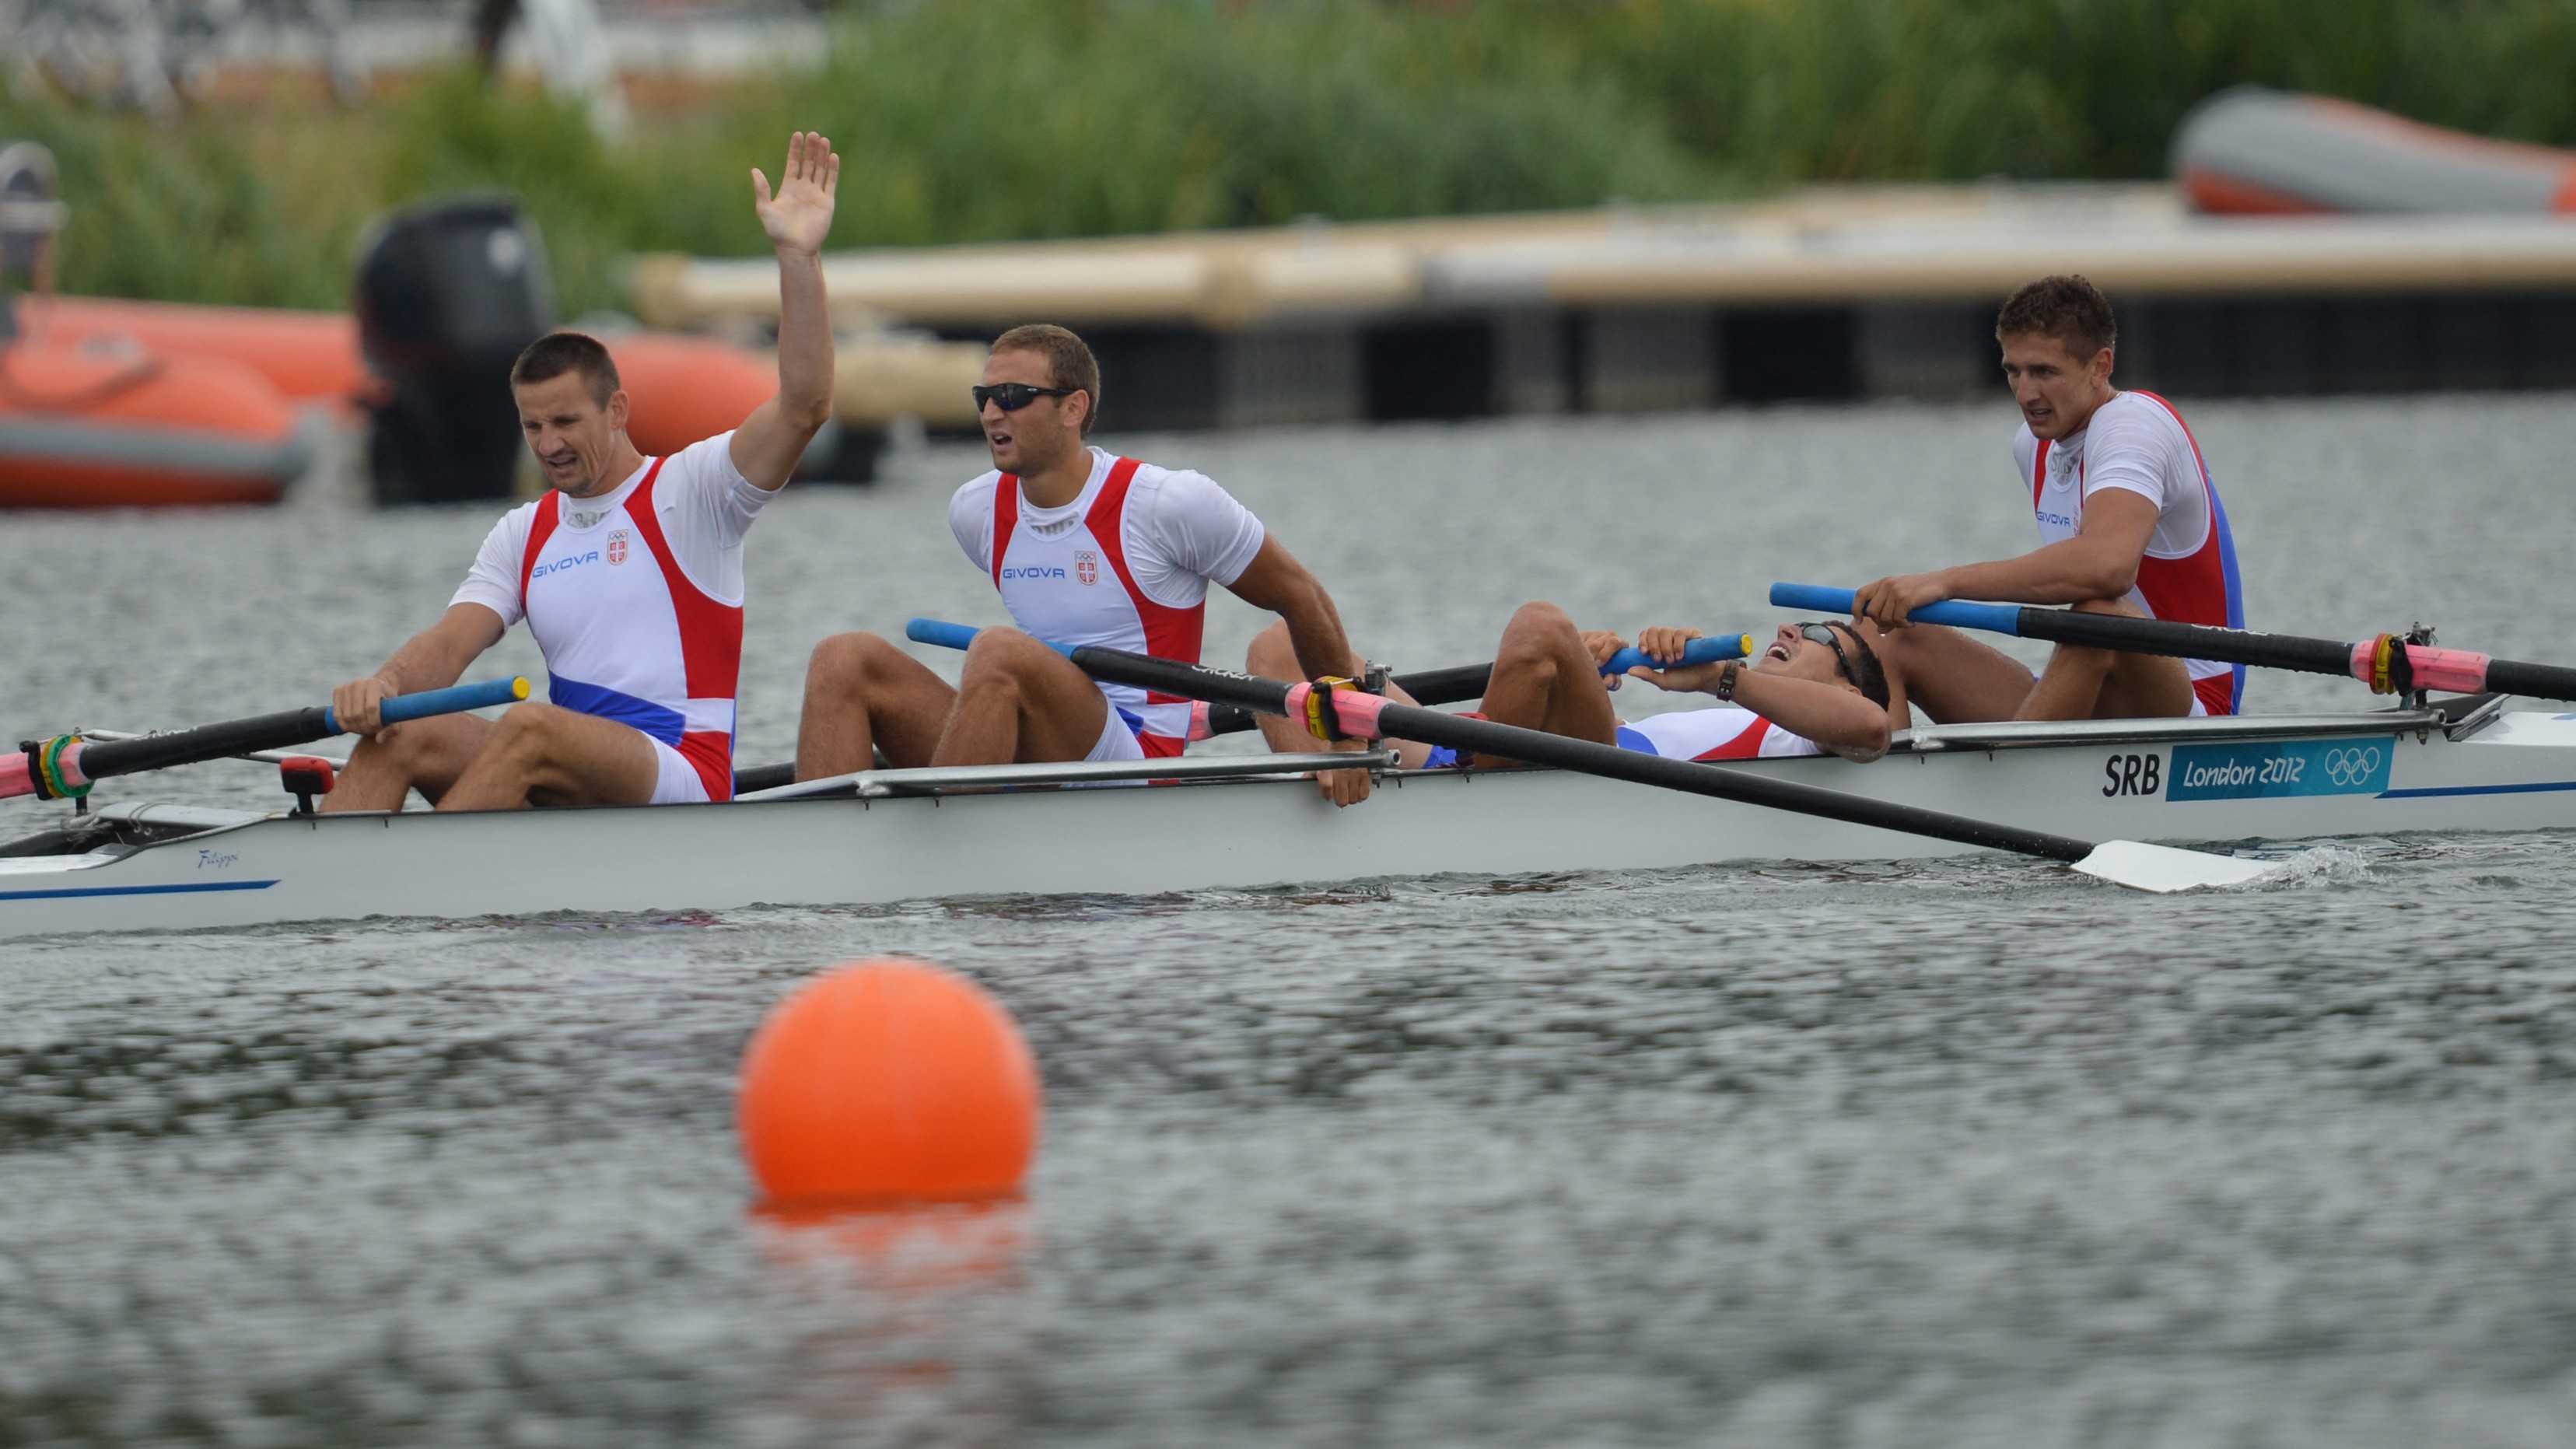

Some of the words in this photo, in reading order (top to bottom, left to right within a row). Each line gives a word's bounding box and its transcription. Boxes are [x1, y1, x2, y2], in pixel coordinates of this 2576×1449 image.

[2037, 511, 2070, 527] GIVOVA
[532, 551, 598, 578] GIVOVA
[1003, 568, 1065, 579] GIVOVA
[2102, 754, 2161, 797] SRB
[2182, 758, 2256, 787] London
[2259, 757, 2306, 784] 2012
